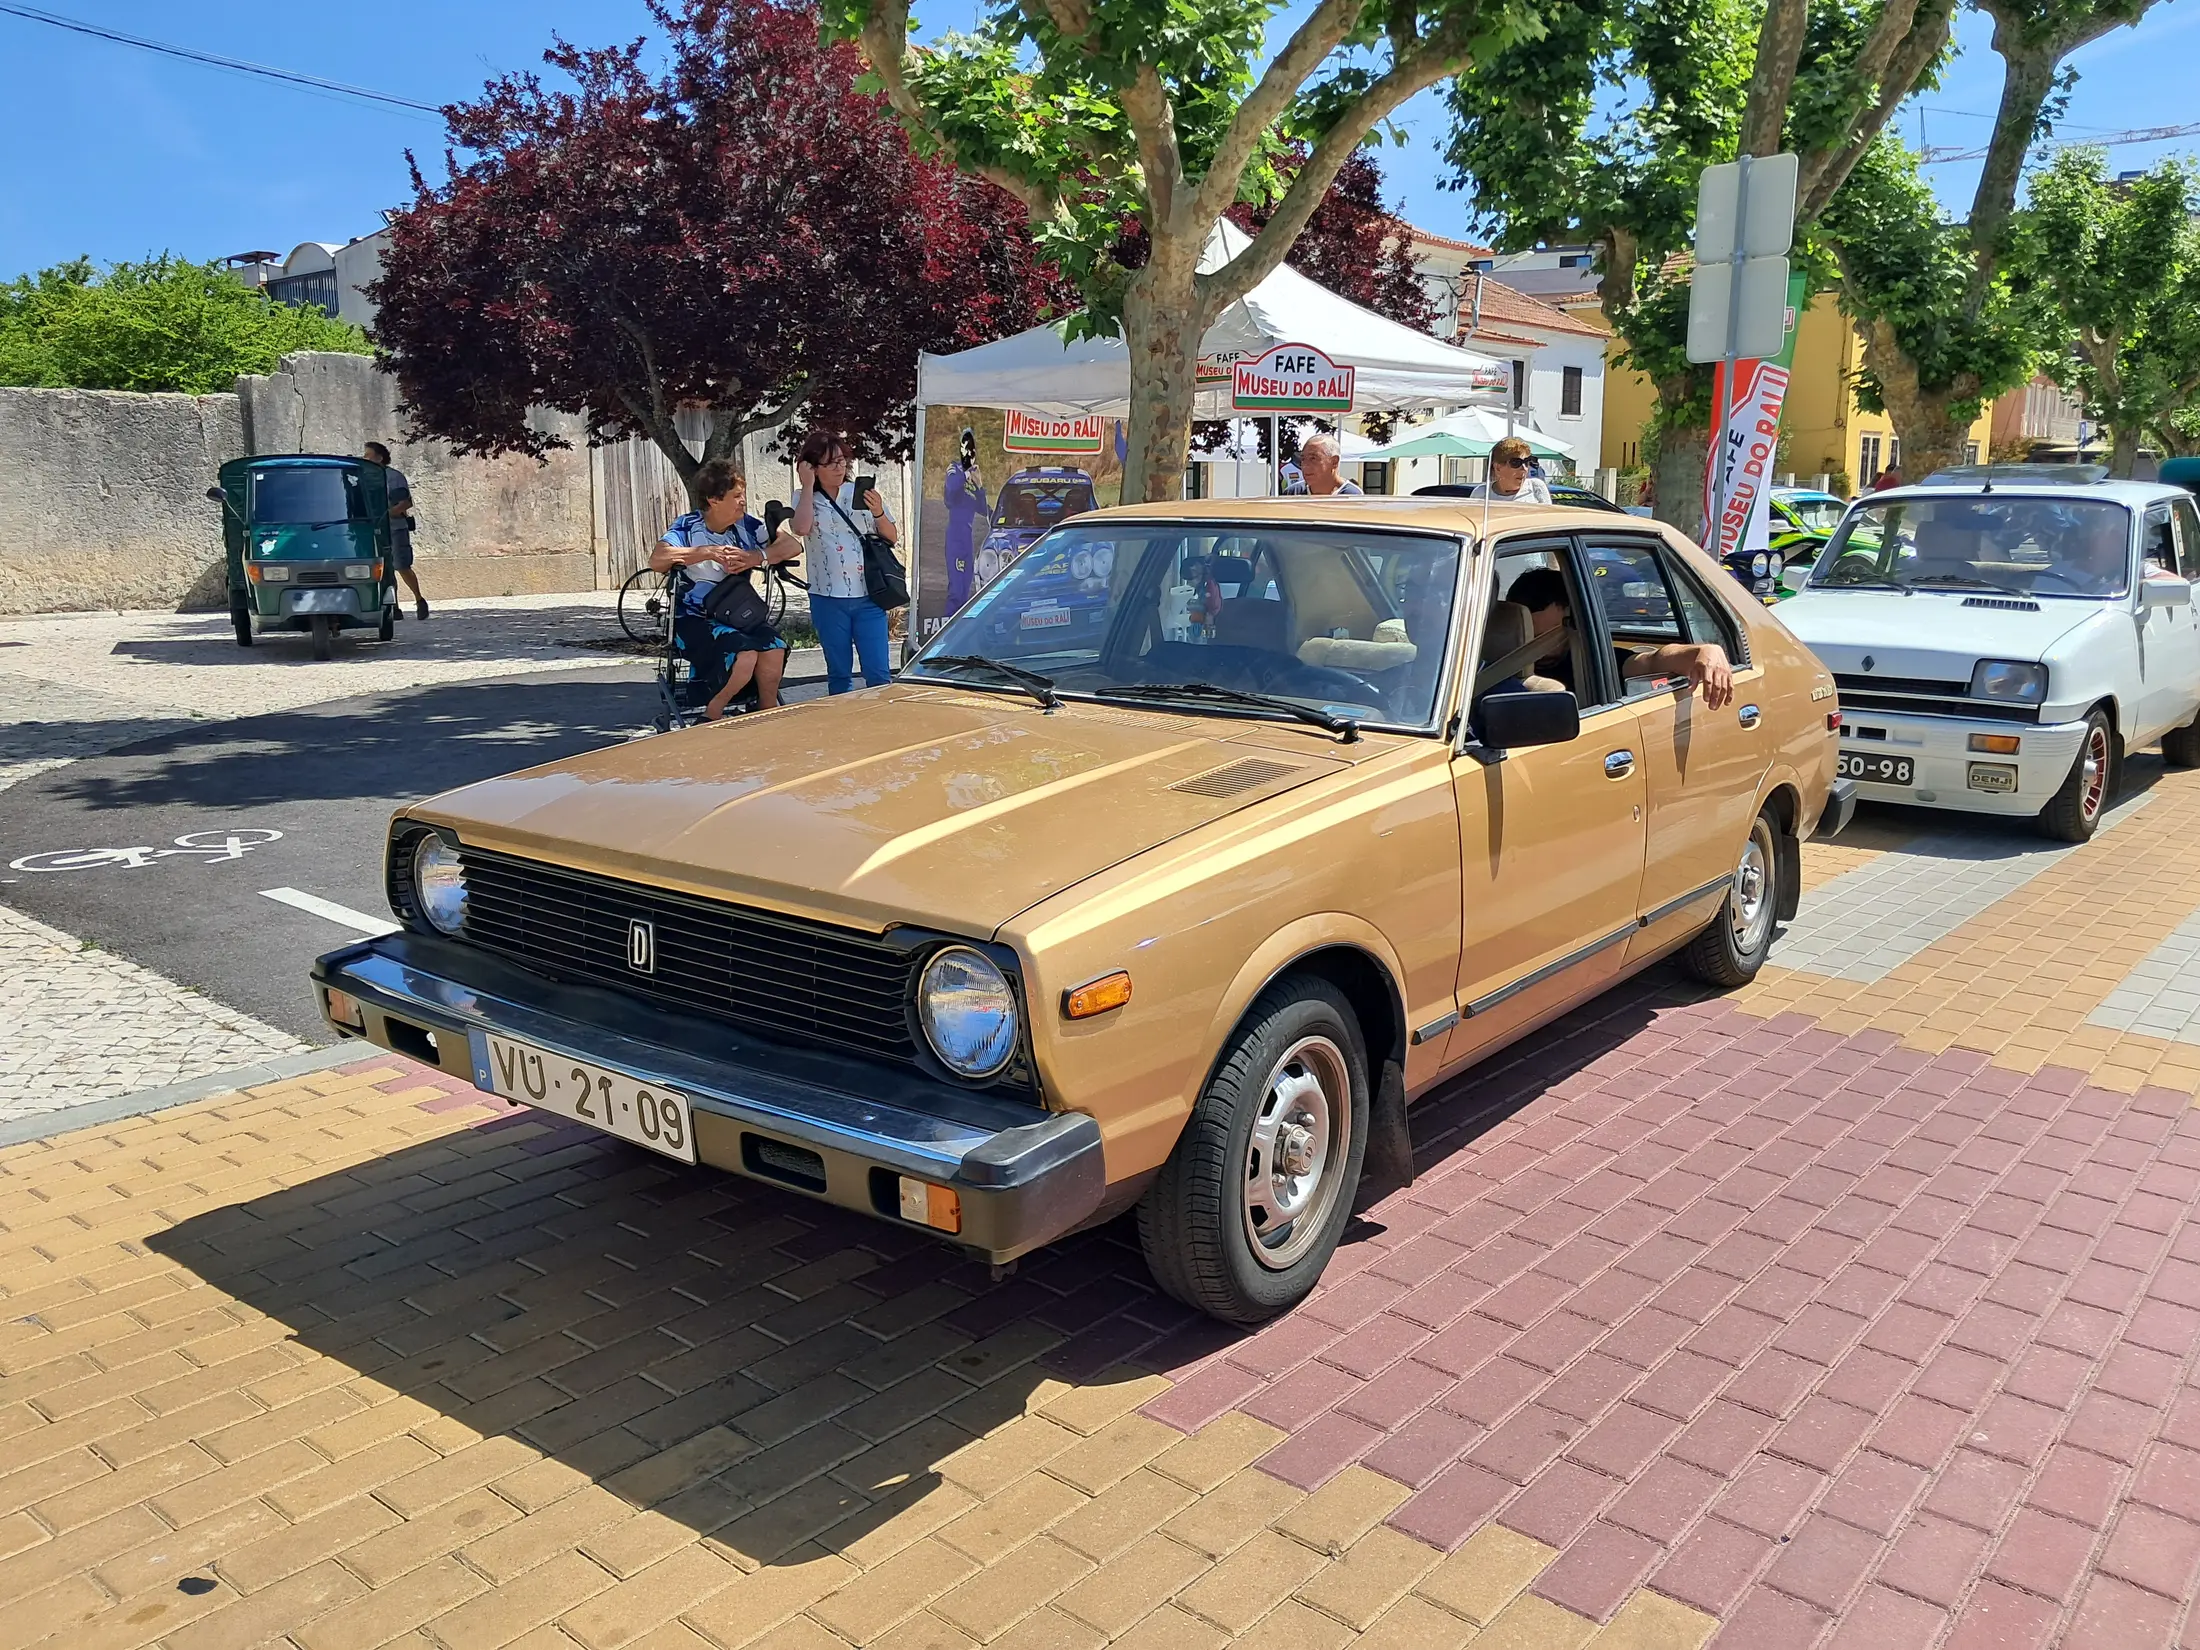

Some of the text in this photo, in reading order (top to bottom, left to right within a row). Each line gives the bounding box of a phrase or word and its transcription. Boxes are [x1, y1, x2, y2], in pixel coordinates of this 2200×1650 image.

[1196, 363, 1224, 376] MUSEU
[1275, 355, 1316, 374] FAFE
[1238, 368, 1350, 397] MUSEU DO RALI
[1010, 410, 1100, 438] MUSEU DO RALI
[1720, 482, 1755, 557] MUSEU
[1743, 442, 1771, 478] DO
[1837, 755, 1910, 781] 50-98
[479, 1069, 488, 1082] P
